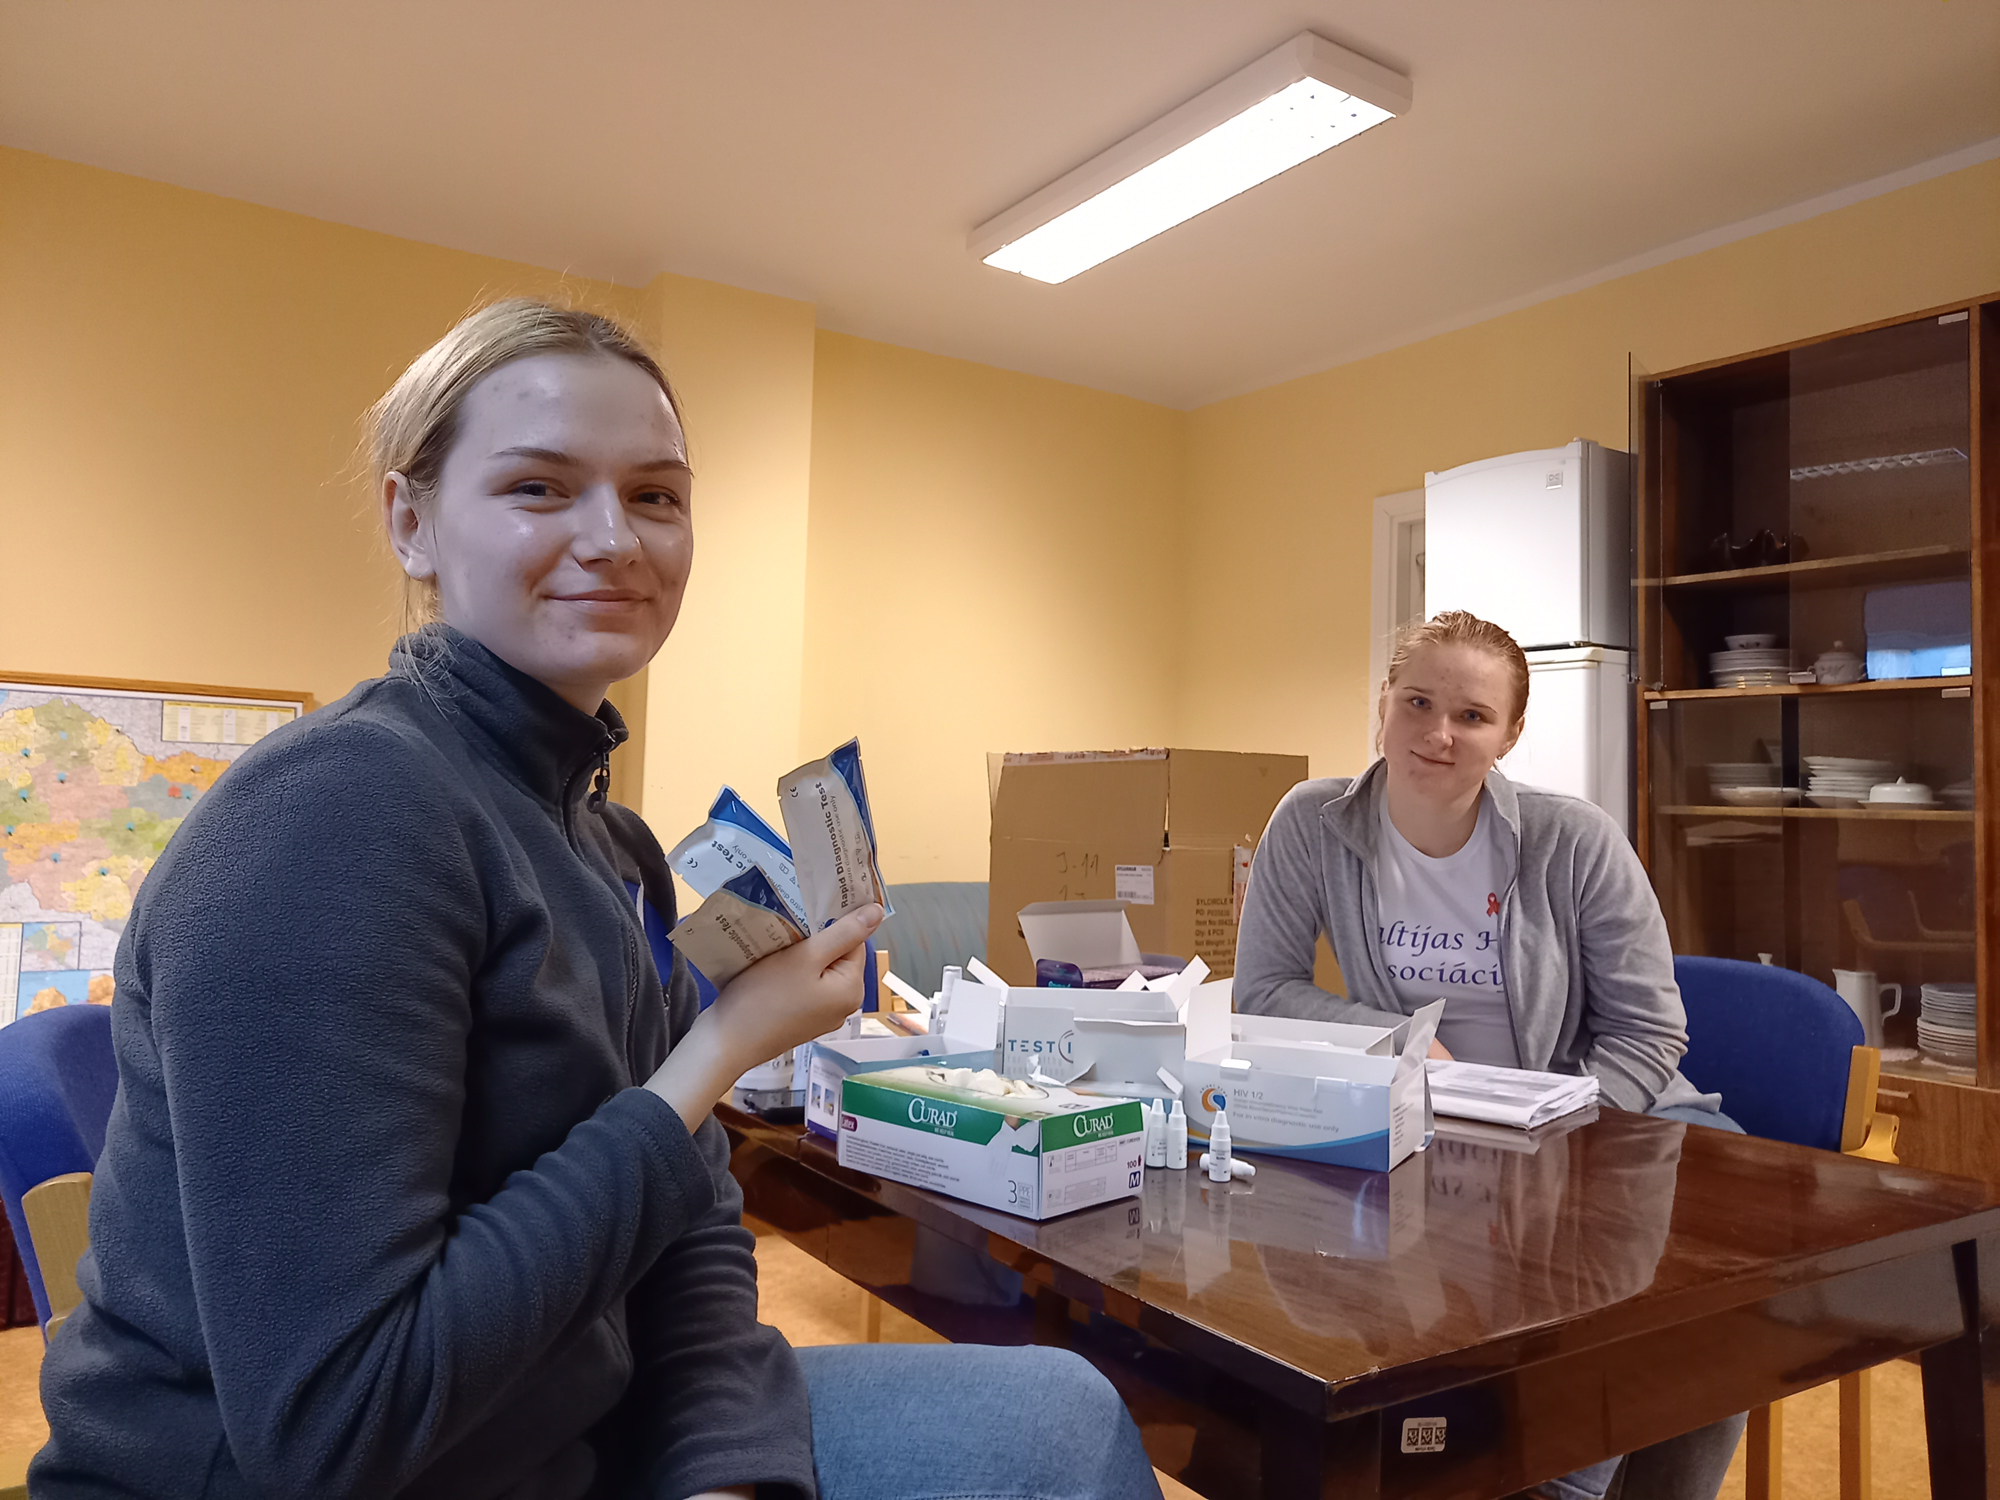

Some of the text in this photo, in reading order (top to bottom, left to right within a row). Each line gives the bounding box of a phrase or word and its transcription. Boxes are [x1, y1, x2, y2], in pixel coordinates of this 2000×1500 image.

[830, 795, 838, 812] only
[834, 814, 842, 828] use
[711, 840, 735, 864] Test
[732, 844, 748, 861] only
[815, 781, 849, 909] Rapid Diagnostic Test
[838, 828, 851, 867] diagnostic
[715, 914, 732, 932] Test
[1233, 1089, 1249, 1097] HIV
[1251, 1091, 1264, 1101] 1/2
[1270, 1117, 1307, 1128] diagnostic
[1323, 1124, 1340, 1133] only
[1127, 1160, 1138, 1169] 100
[1129, 1172, 1140, 1188] M
[1008, 1179, 1018, 1204] 3
